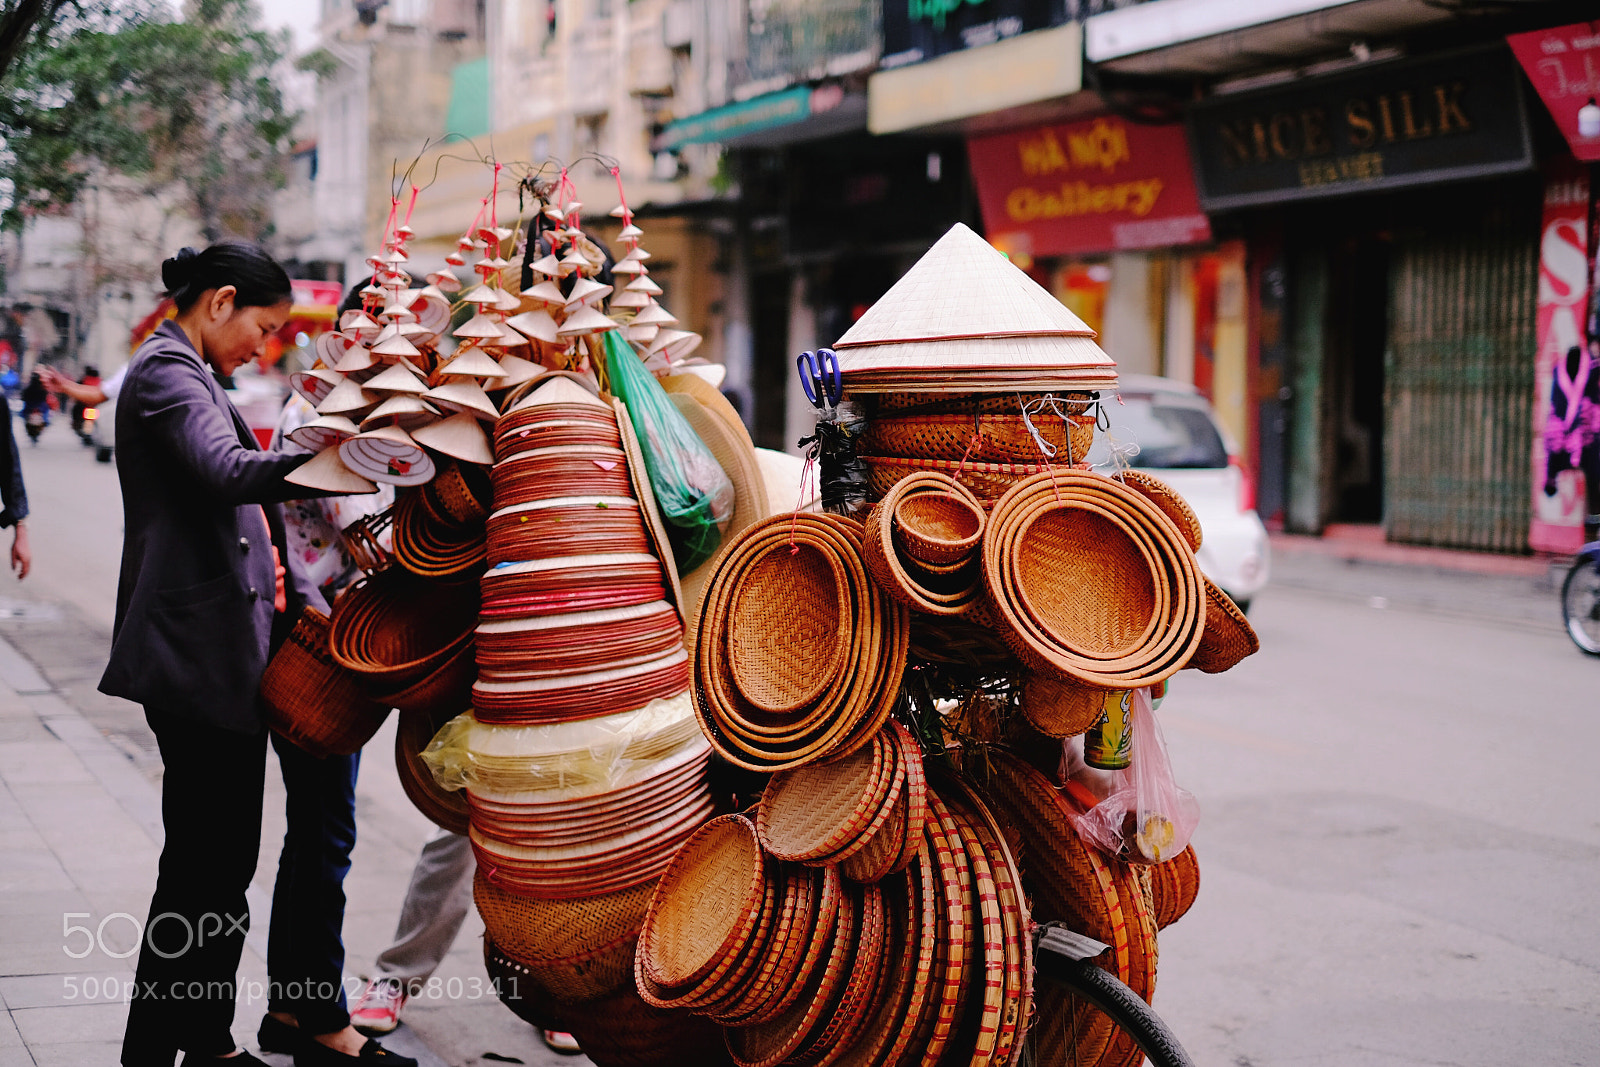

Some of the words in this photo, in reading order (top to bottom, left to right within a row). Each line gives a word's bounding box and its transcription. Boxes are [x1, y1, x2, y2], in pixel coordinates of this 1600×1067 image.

[1218, 106, 1332, 170] NICE
[1345, 82, 1473, 149] SILK
[1006, 176, 1164, 223] Gallery
